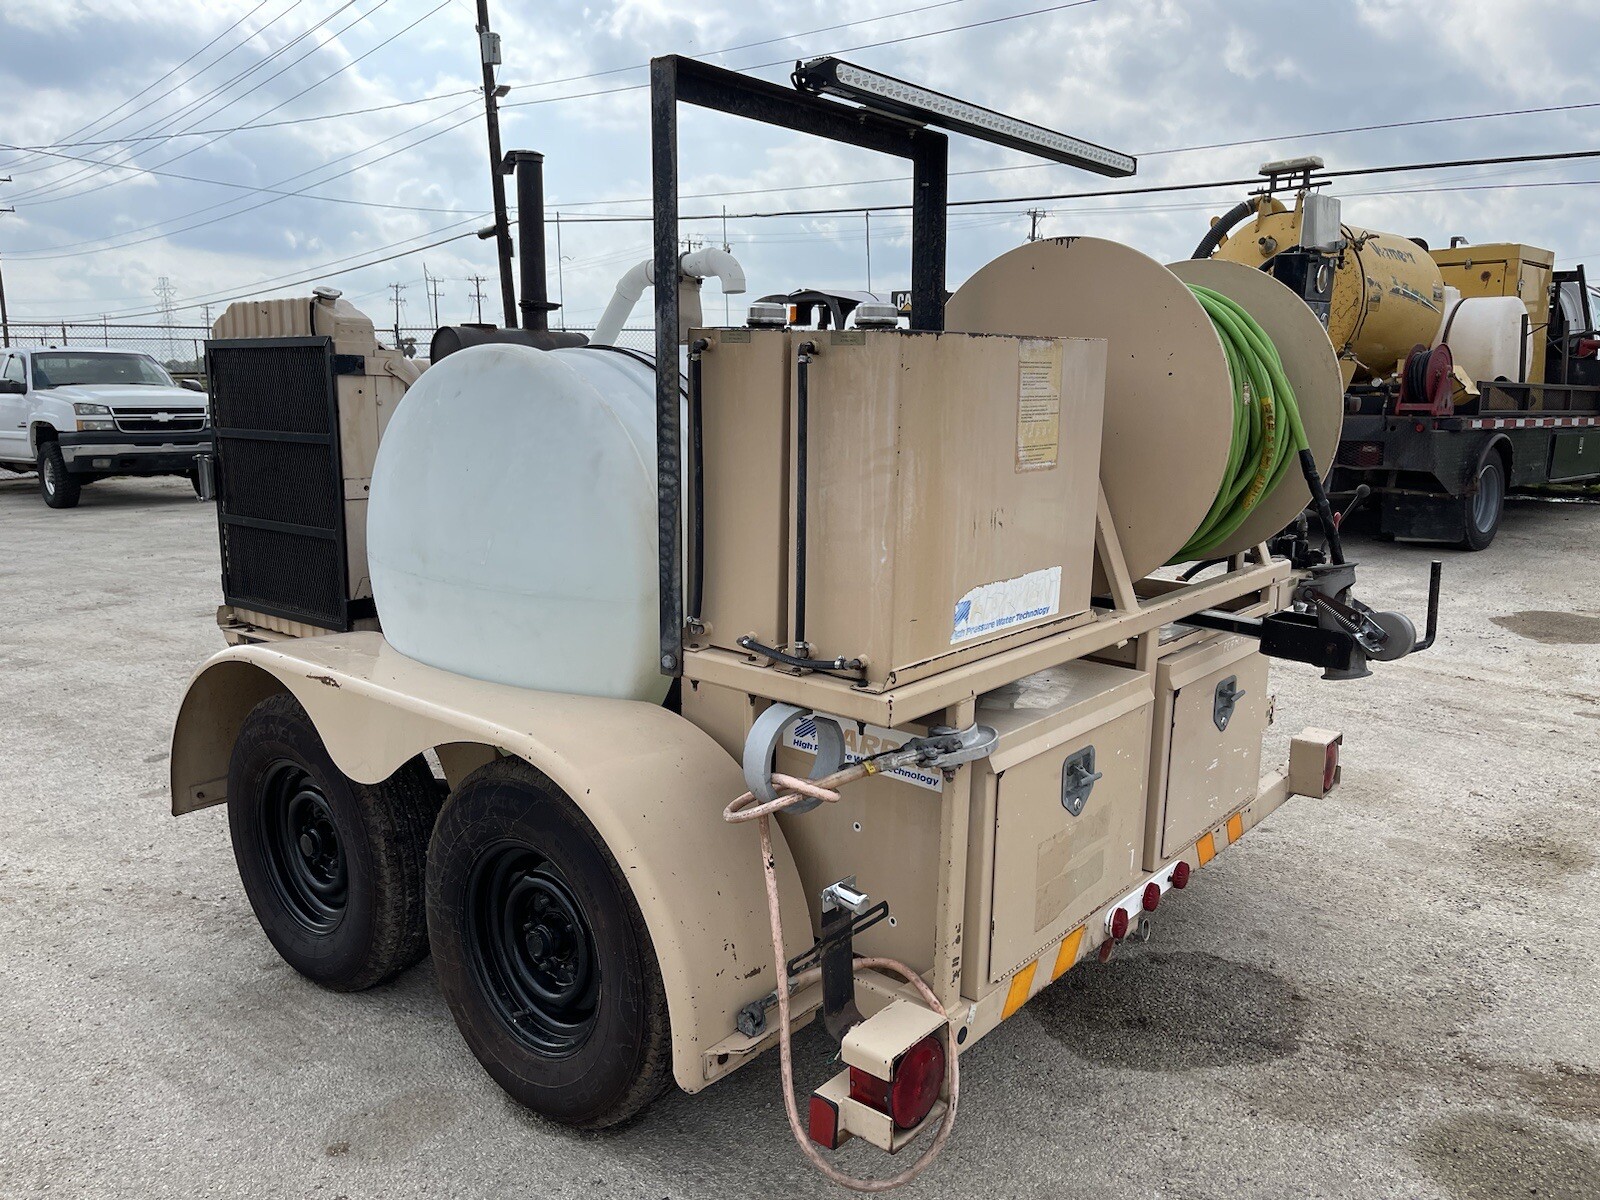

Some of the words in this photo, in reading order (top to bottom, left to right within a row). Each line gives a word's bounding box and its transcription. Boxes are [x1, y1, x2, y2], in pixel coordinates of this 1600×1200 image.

[897, 293, 912, 310] CA
[966, 621, 995, 635] Pressure
[996, 615, 1015, 626] Water
[1015, 606, 1049, 621] Technology
[793, 739, 813, 750] High
[888, 766, 939, 786] chnology
